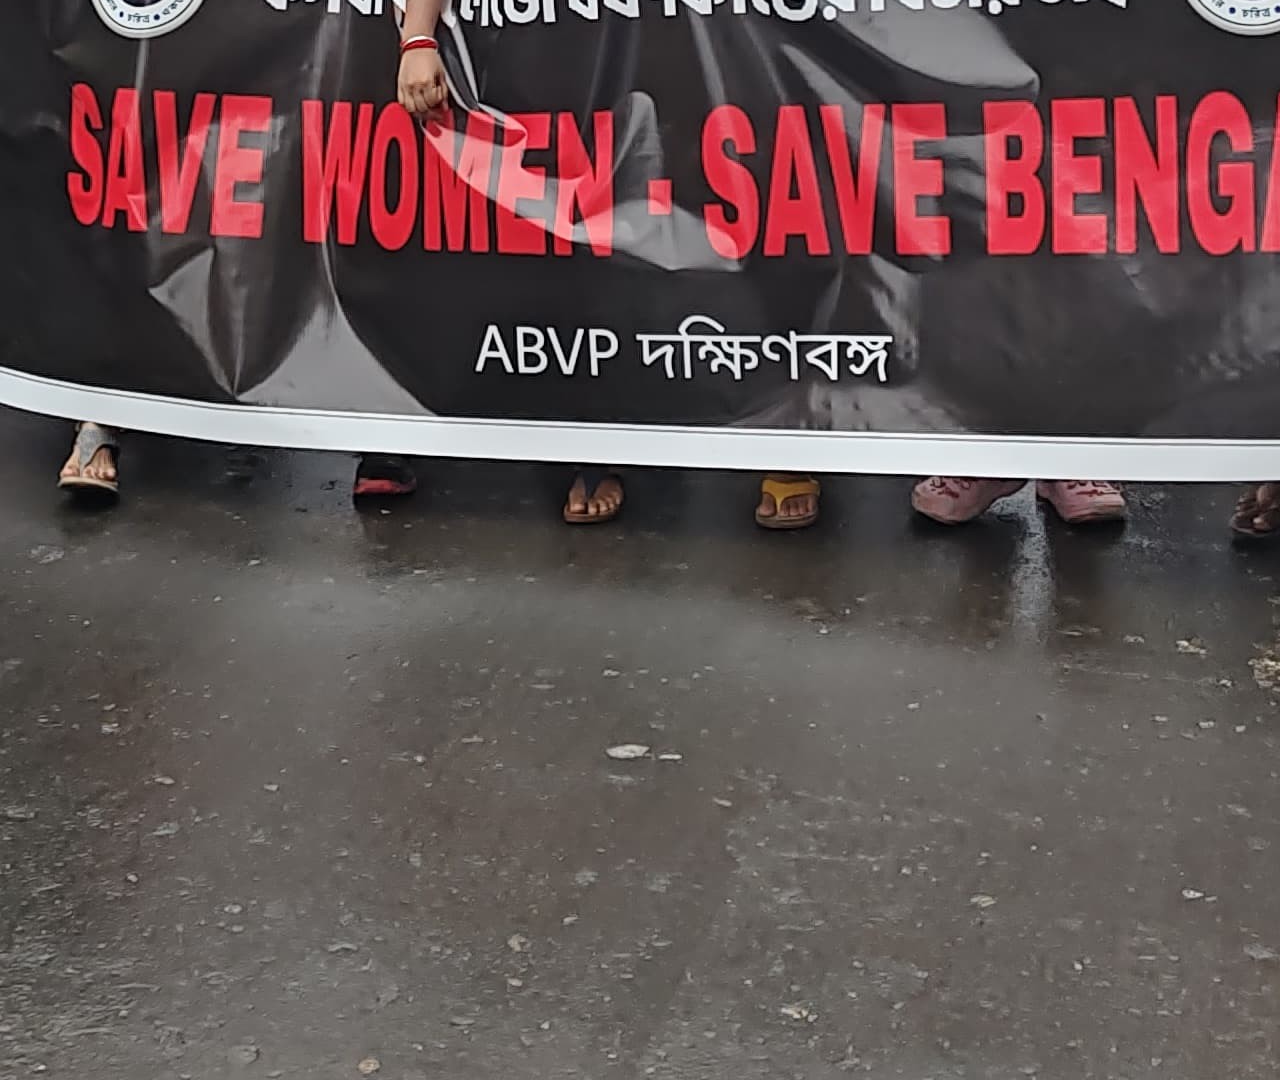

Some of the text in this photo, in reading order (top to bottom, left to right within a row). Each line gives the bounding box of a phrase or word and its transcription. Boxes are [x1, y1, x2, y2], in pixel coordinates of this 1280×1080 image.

[66, 83, 273, 239] SAVE
[302, 98, 614, 257] WOMEN
[700, 102, 952, 259] SAVE
[475, 314, 893, 383] ABVP দক্ষিণবঙ্গ
